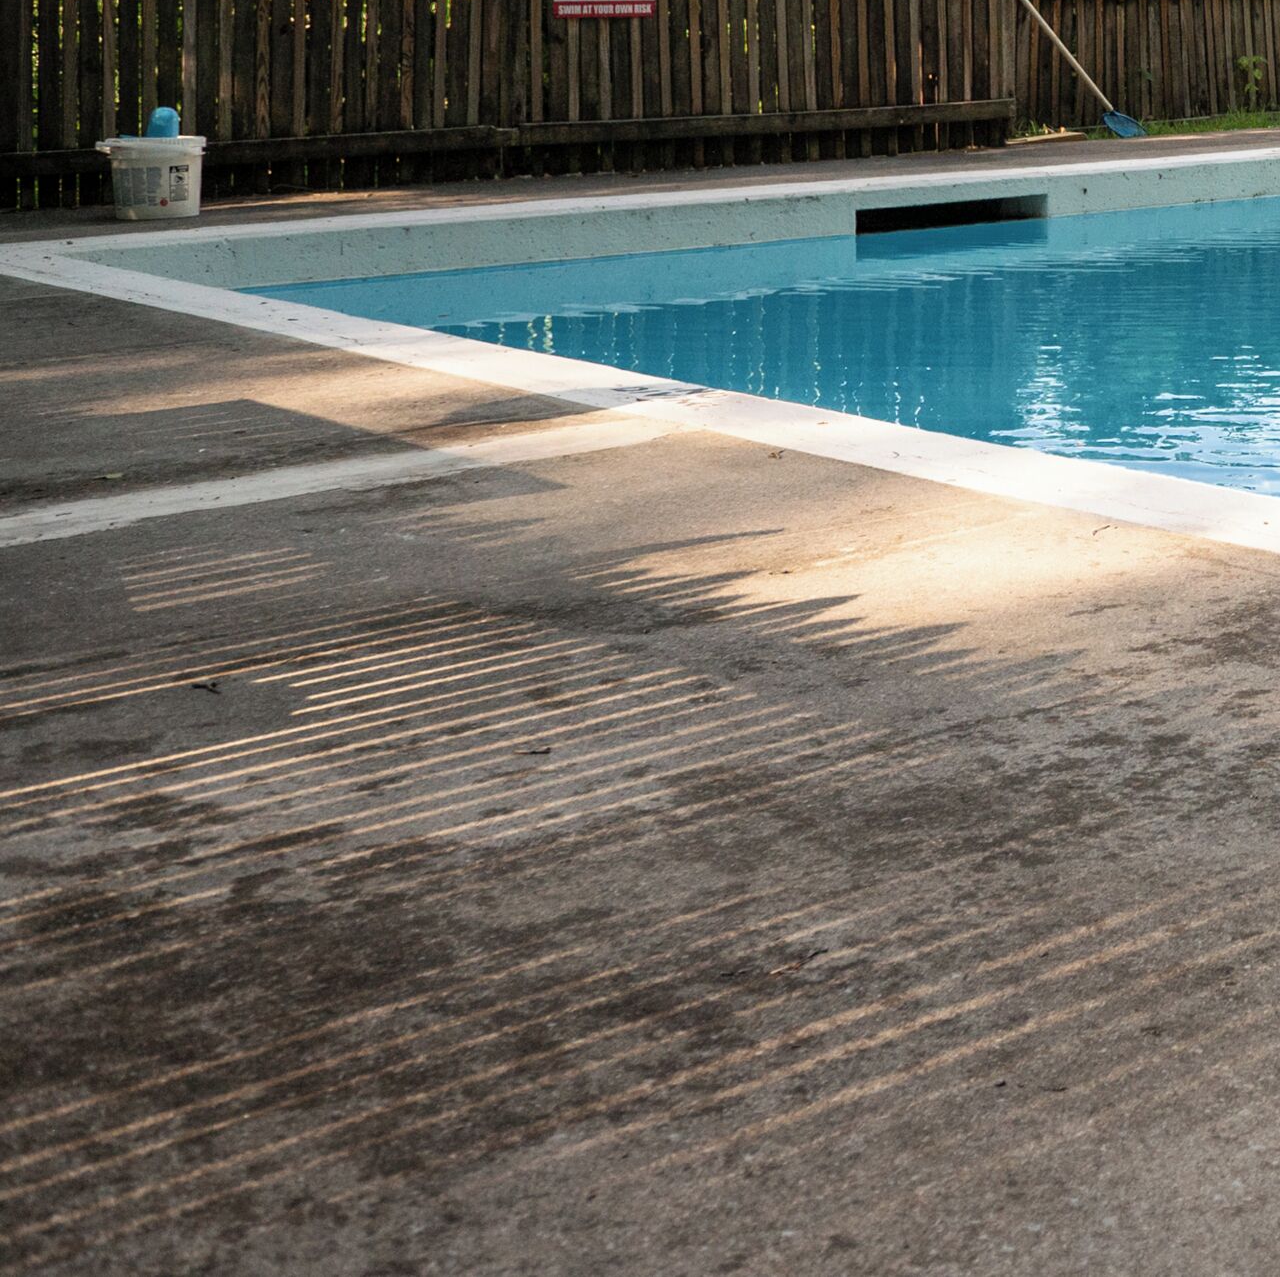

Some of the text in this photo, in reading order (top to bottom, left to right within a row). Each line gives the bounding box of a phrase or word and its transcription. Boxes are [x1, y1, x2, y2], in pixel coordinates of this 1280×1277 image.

[558, 3, 652, 15] SWIM AT YOUR OWN RISK
